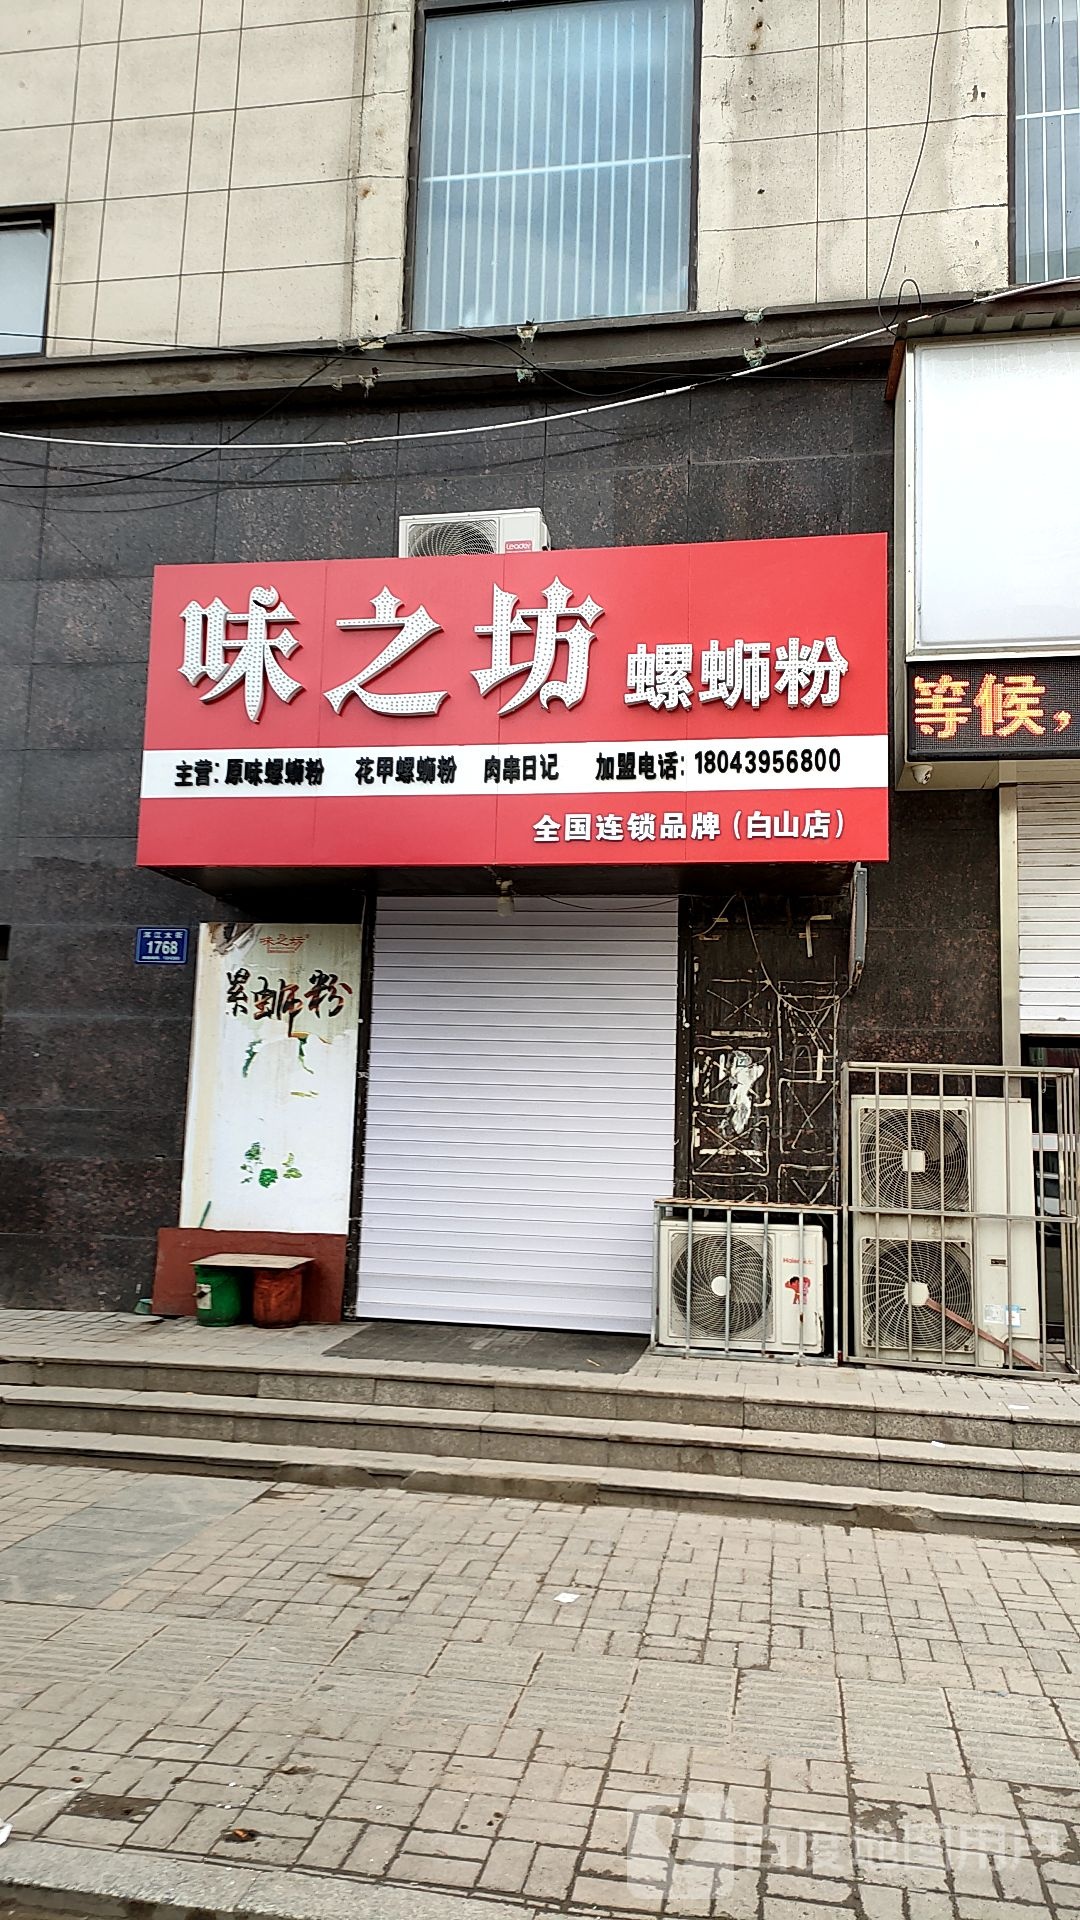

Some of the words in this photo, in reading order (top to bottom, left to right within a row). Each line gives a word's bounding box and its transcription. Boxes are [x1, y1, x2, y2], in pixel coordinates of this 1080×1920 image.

[178, 575, 605, 723] 味之坊
[624, 636, 849, 711] 螺蛳粉
[355, 755, 458, 785] 花甲螺蛳粉
[484, 753, 560, 785] 肉串日记
[146, 940, 178, 955] 1768
